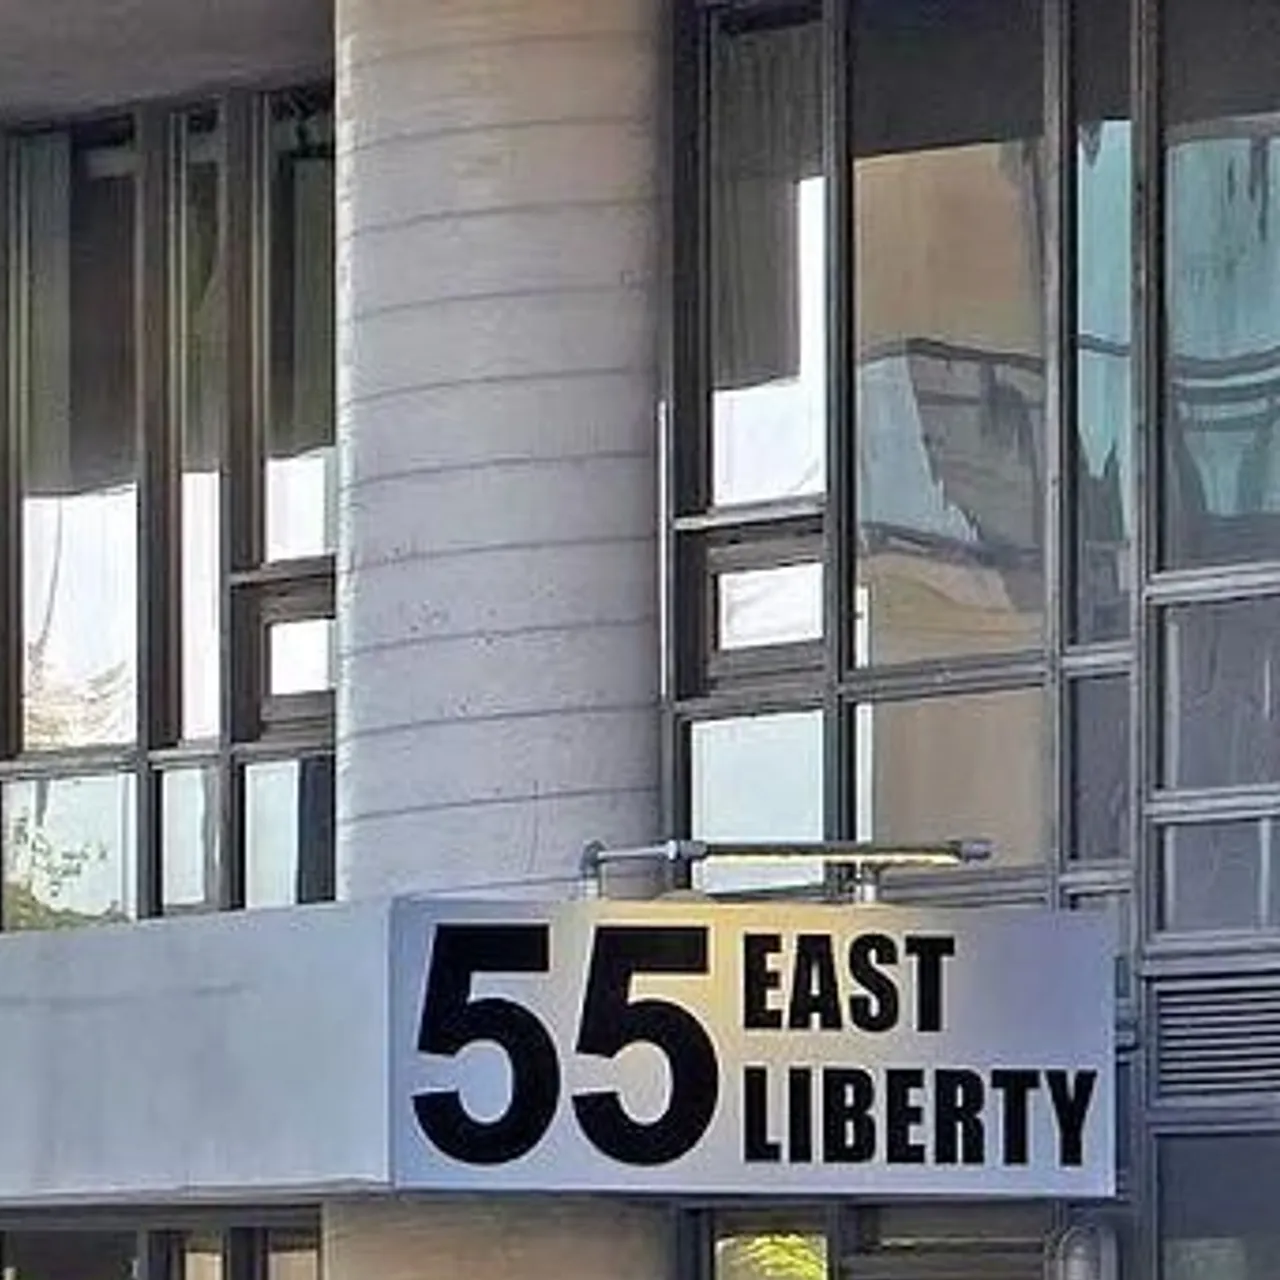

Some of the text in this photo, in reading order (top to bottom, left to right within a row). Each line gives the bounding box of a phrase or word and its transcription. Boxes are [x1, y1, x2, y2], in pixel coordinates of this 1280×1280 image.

[744, 933, 955, 1033] EAST
[413, 923, 719, 1166] 55
[744, 1066, 1097, 1167] LIBERTY
